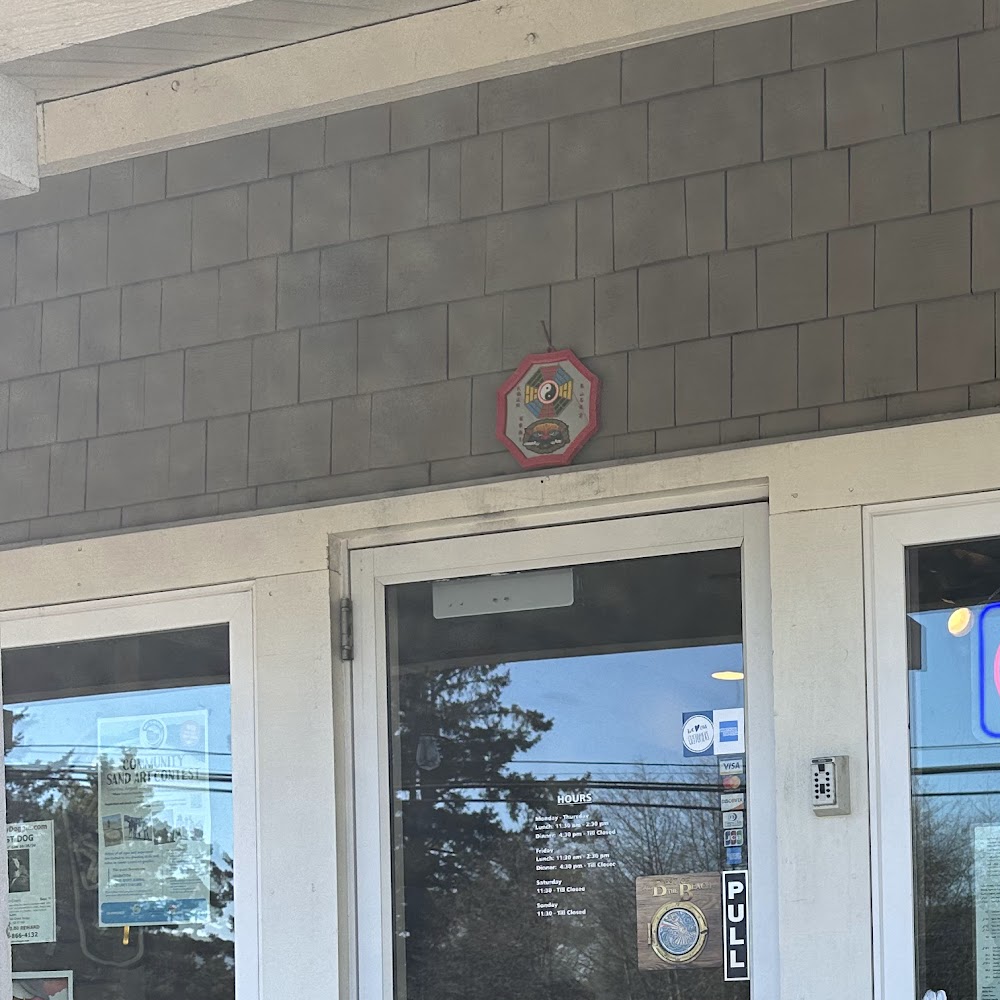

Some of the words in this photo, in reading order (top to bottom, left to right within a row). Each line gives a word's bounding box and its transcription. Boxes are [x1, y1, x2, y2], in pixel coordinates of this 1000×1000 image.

[723, 762, 740, 770] VISA
[106, 772, 132, 786] SAND
[134, 770, 151, 783] ART
[557, 793, 592, 804] HOURS
[17, 833, 34, 843] DOG
[679, 881, 712, 902] BEACH
[728, 880, 745, 968] PULL
